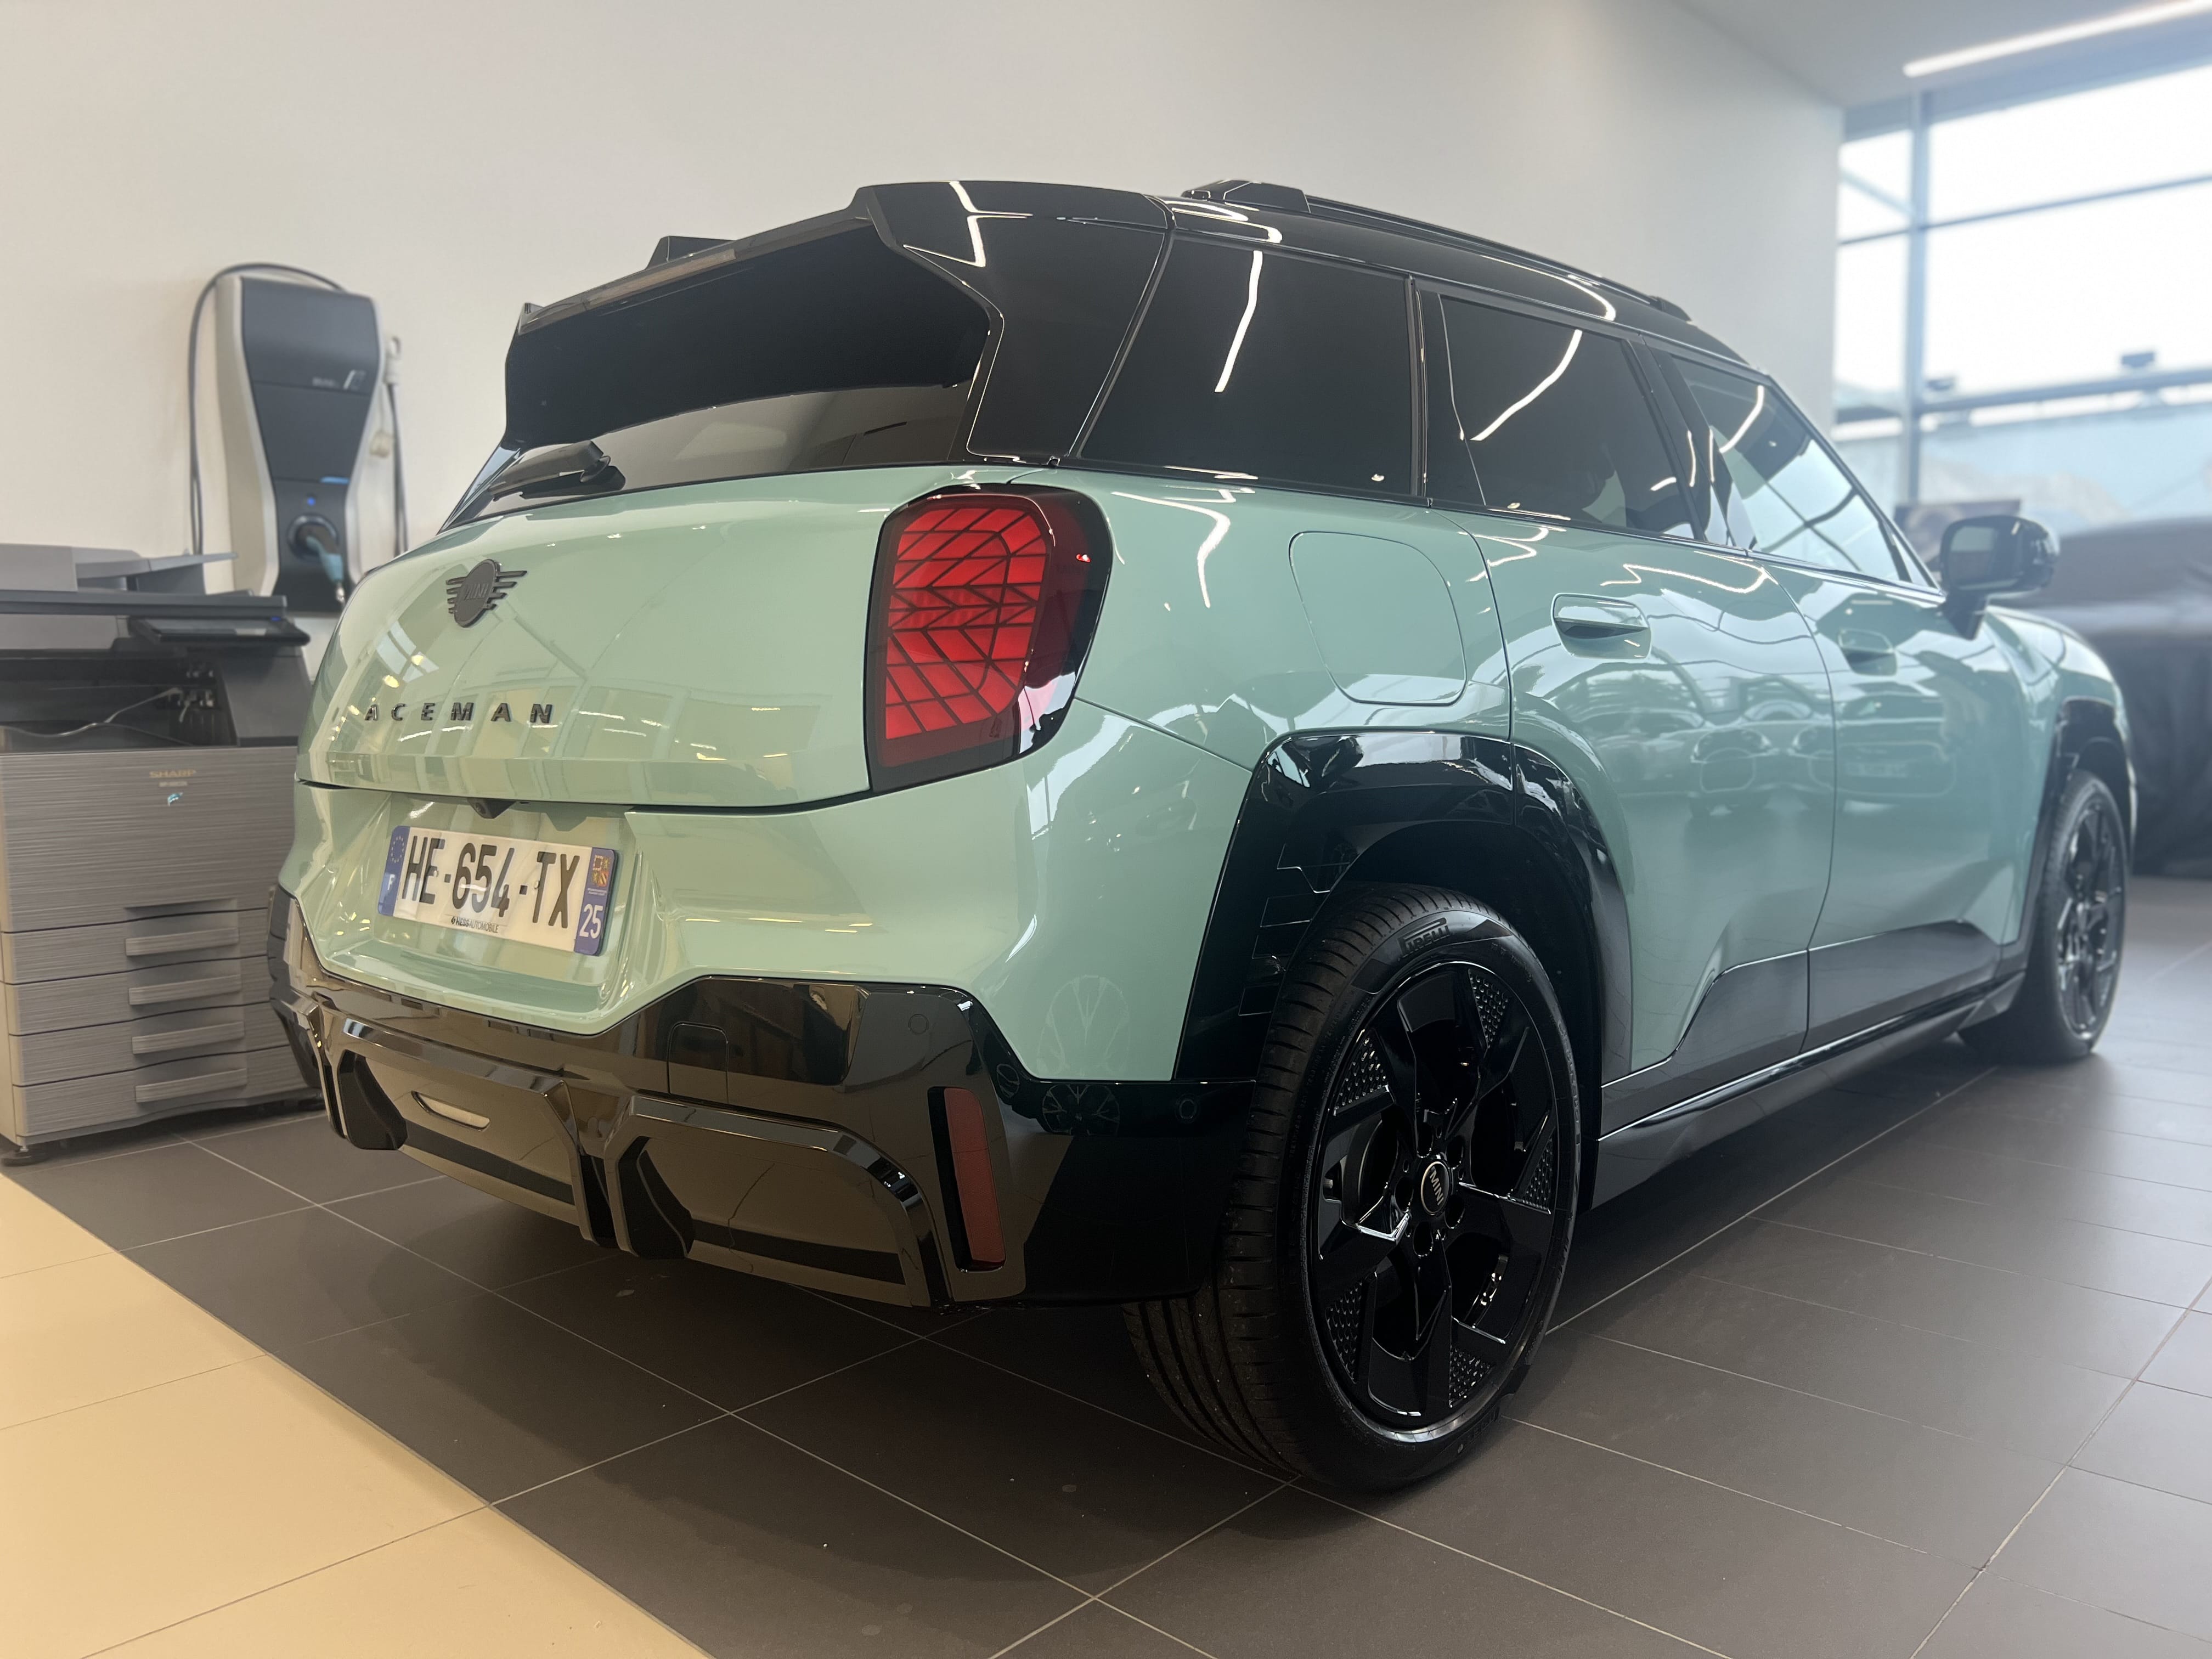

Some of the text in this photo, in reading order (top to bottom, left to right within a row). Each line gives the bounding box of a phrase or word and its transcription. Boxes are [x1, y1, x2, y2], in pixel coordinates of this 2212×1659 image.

[364, 702, 552, 723] ACEMAN
[387, 873, 396, 890] F
[402, 836, 580, 928] HE-654-TX
[579, 904, 603, 939] 25
[1397, 917, 1449, 958] PIRELLI
[1430, 1169, 1444, 1205] MINI
